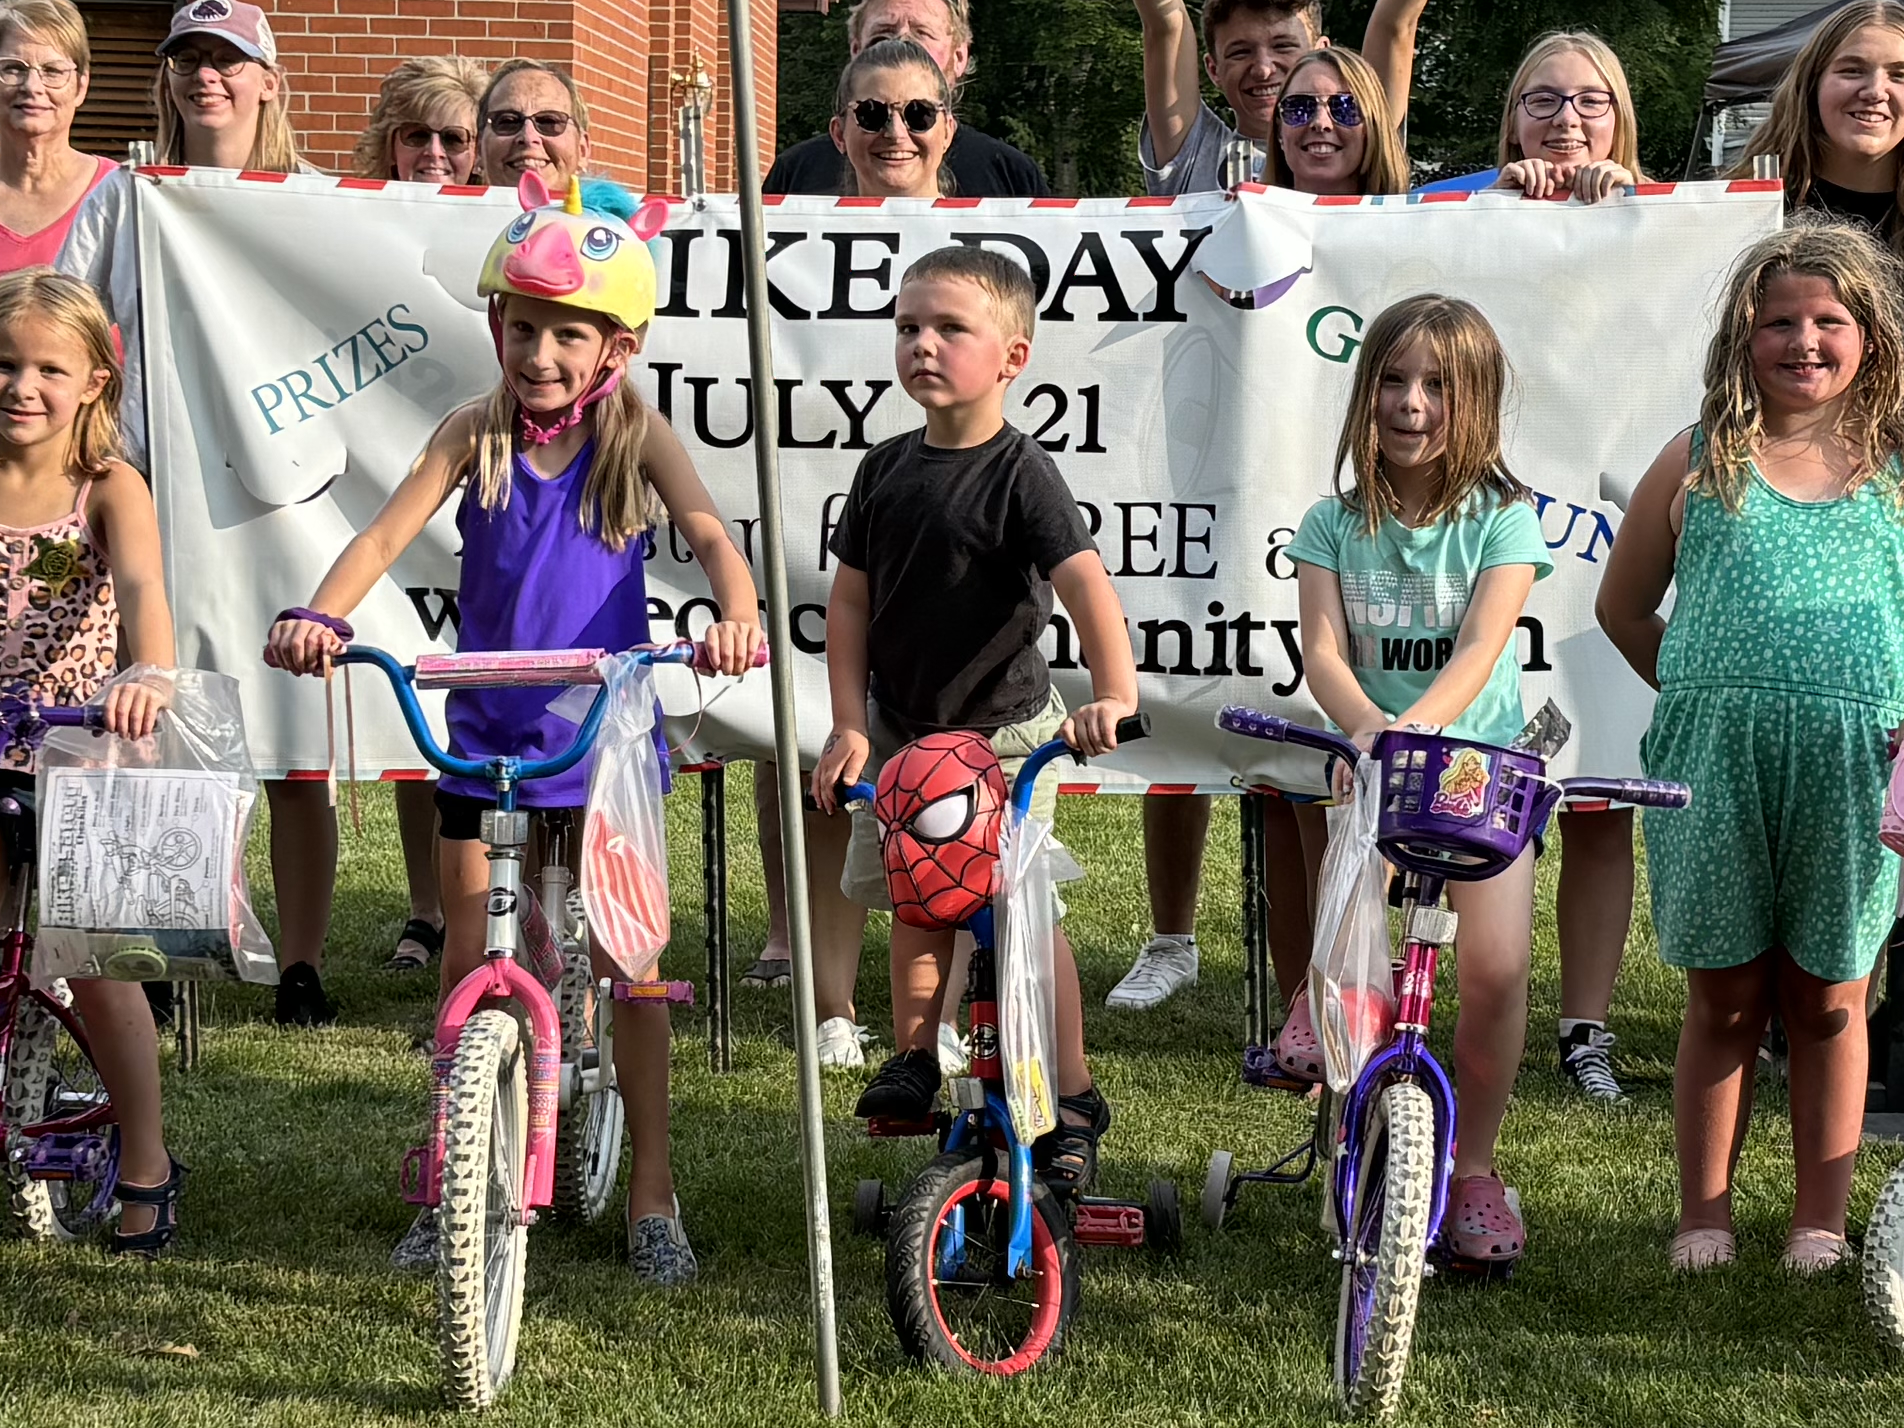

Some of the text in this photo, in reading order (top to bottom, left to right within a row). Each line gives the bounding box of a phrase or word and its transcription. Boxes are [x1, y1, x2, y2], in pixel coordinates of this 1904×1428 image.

[654, 228, 899, 320] IKE
[251, 303, 429, 435] PRIZES
[1023, 383, 1107, 454] 21
[1529, 486, 1616, 564] UN
[1381, 636, 1459, 672] WOR
